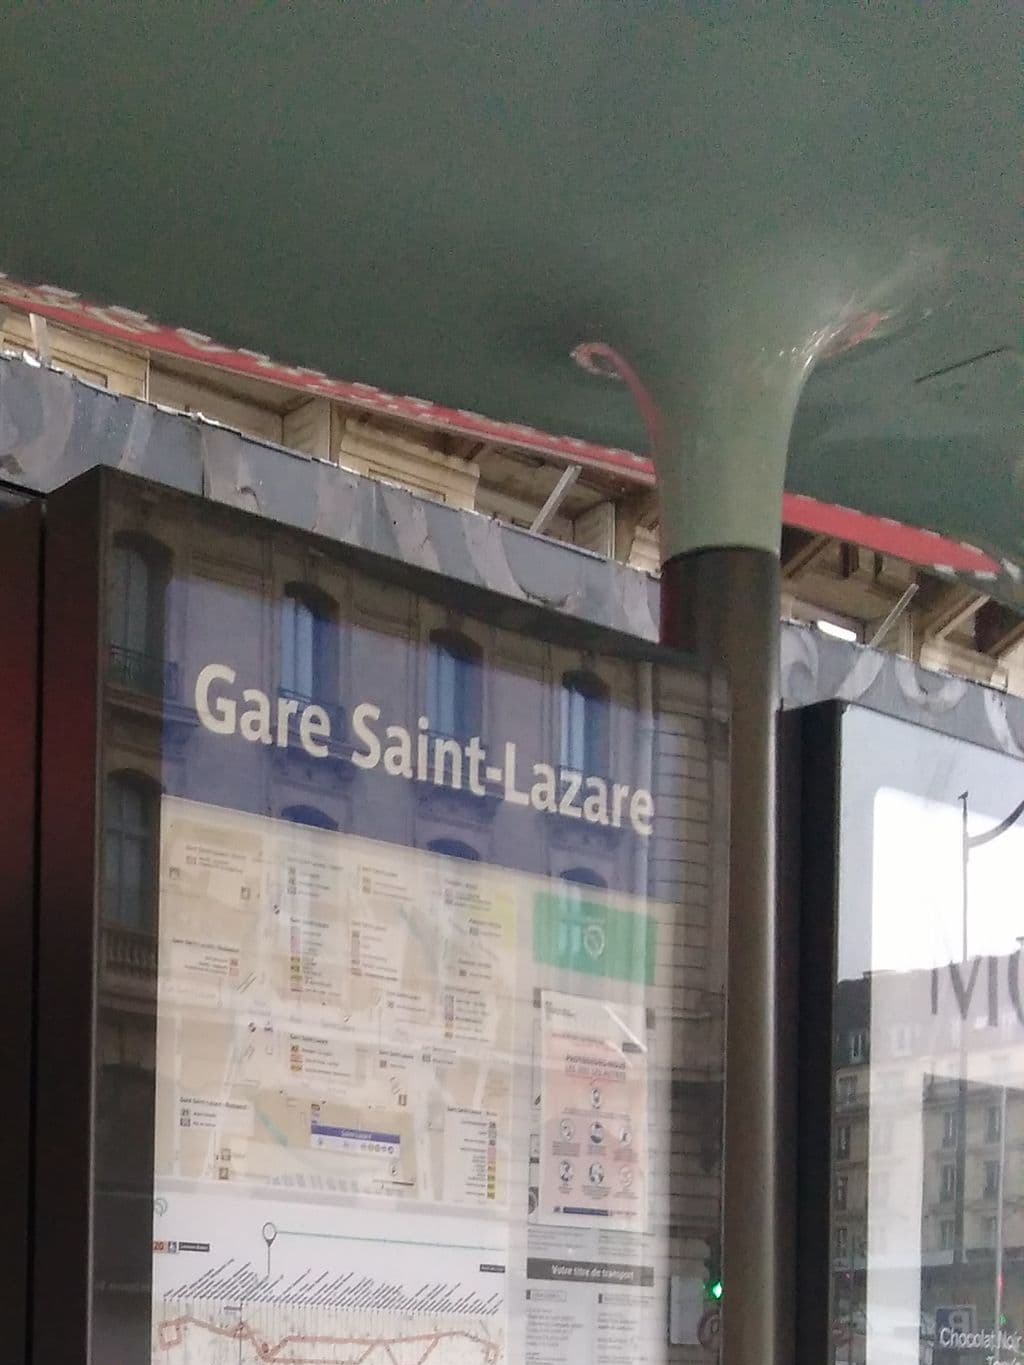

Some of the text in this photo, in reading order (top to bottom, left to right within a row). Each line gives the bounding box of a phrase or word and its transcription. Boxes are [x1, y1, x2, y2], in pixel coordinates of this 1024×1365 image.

[194, 662, 655, 835] Gare Saint-Lazare
[552, 1265, 573, 1275] Votre
[939, 1327, 1023, 1350] Chocolat Noir
